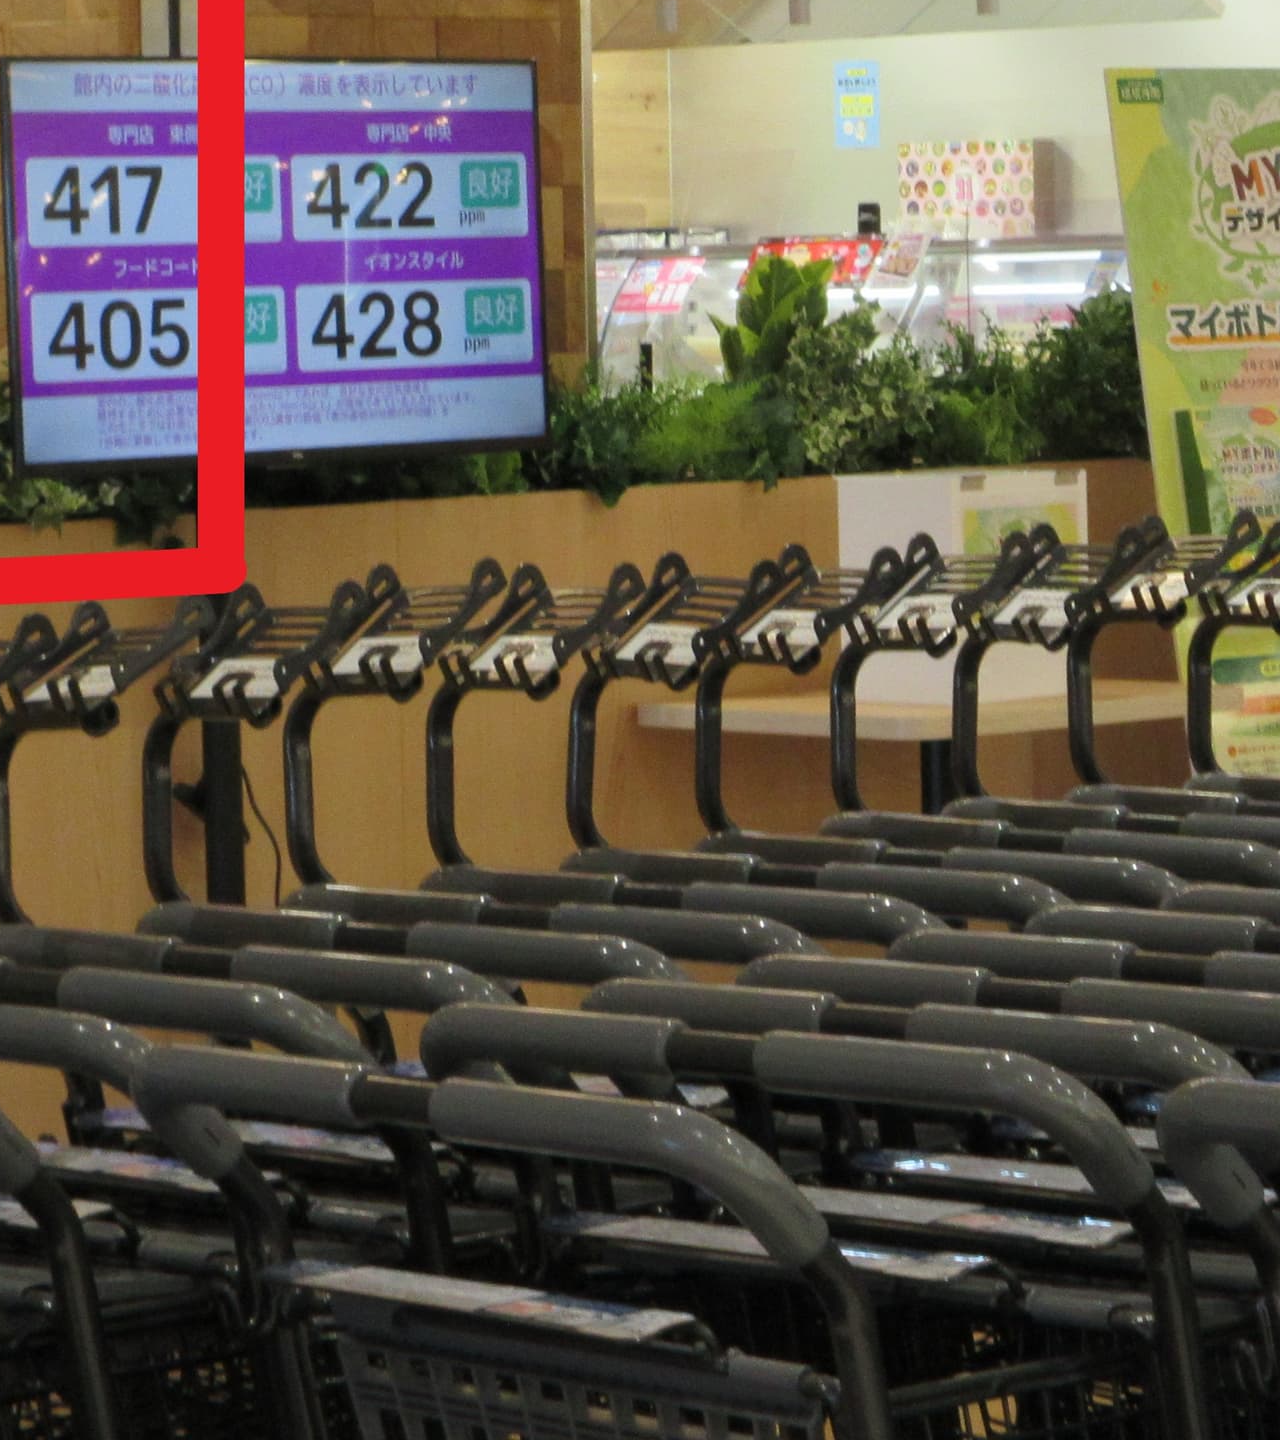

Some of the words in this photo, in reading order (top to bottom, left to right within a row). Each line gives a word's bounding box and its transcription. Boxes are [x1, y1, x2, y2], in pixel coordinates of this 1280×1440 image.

[42, 165, 163, 236] 417
[306, 161, 437, 230] 422
[467, 166, 512, 200] 良好
[48, 297, 191, 370] 405
[311, 290, 443, 360] 428
[471, 292, 518, 327] 良好
